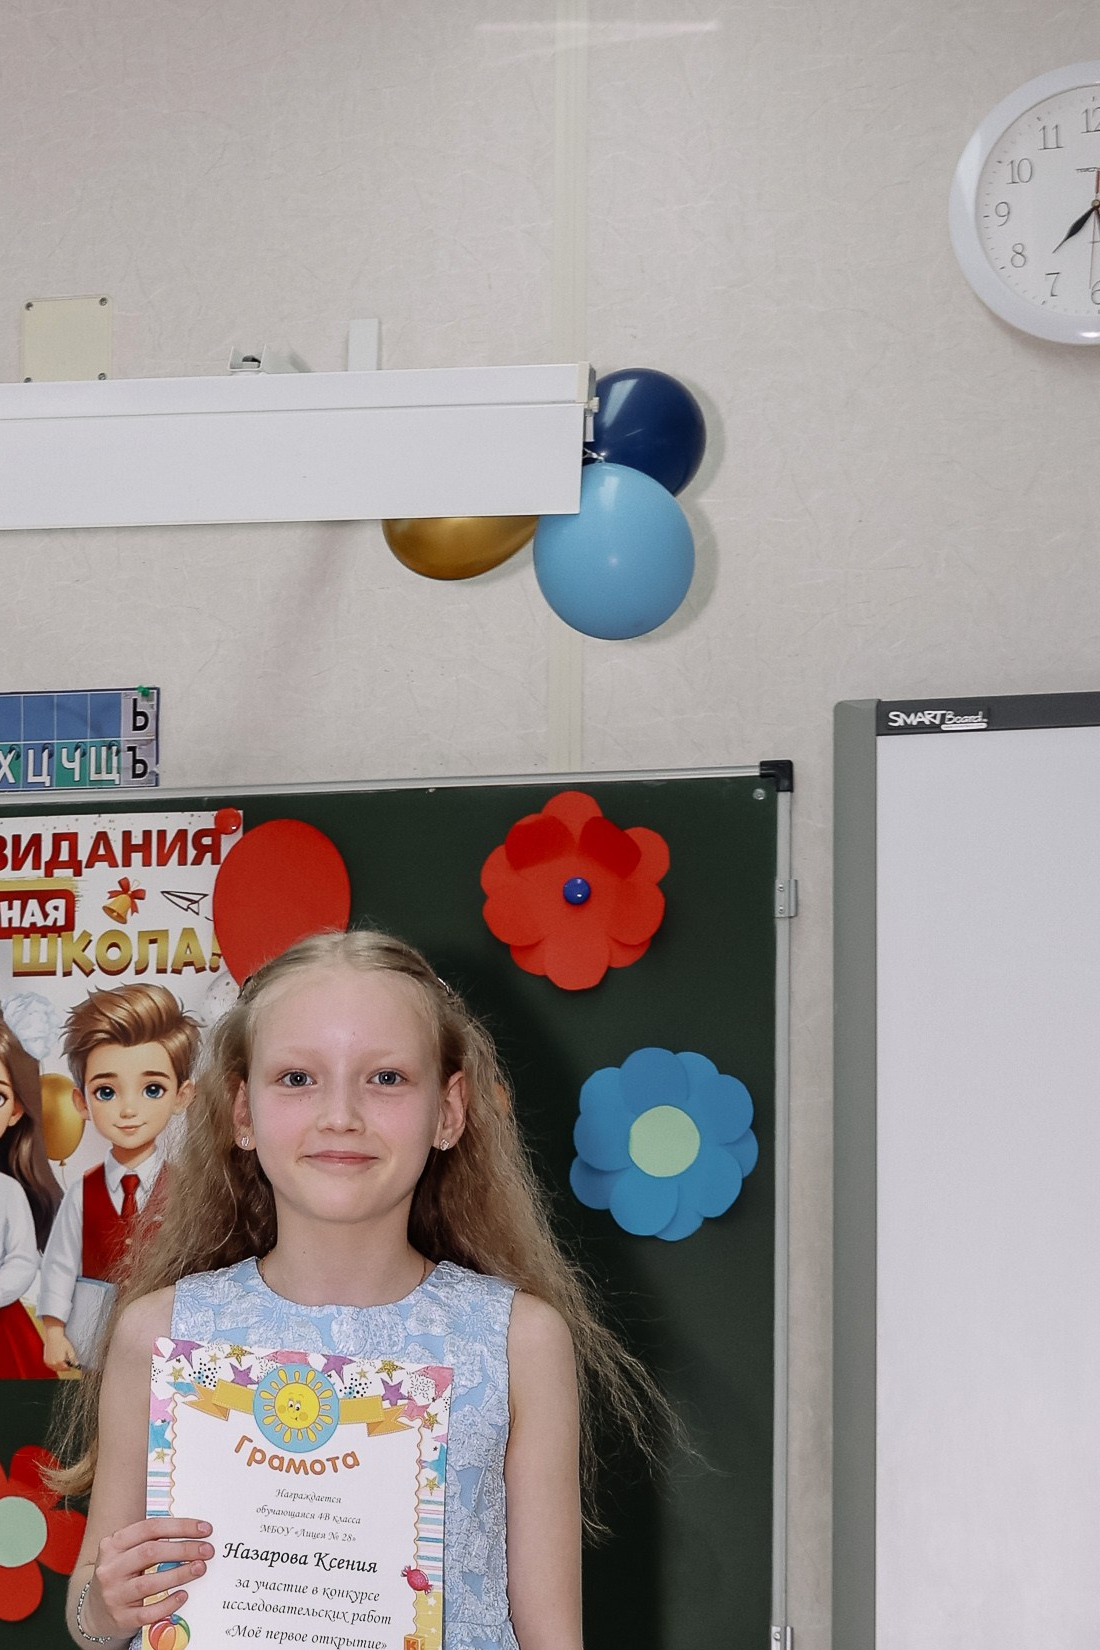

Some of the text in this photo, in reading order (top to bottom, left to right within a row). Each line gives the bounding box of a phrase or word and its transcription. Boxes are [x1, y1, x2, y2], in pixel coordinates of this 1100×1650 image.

[1038, 124, 1065, 150] 11
[1006, 158, 1033, 185] 10
[995, 201, 1011, 227] 9
[1010, 243, 1027, 268] 8
[1045, 272, 1061, 297] 7
[888, 711, 947, 727] SMART
[234, 1435, 360, 1476] Грамота
[275, 1488, 341, 1503] Награждается
[256, 1504, 315, 1519] обучающаяся
[332, 1515, 361, 1524] класса
[259, 1524, 294, 1536] МБОУ
[222, 1542, 378, 1573] Назарова Ксения
[235, 1578, 380, 1604] за участие в конкурсе
[222, 1598, 392, 1626] исследовательских работ
[225, 1624, 388, 1650] «Моё первое открытие»
